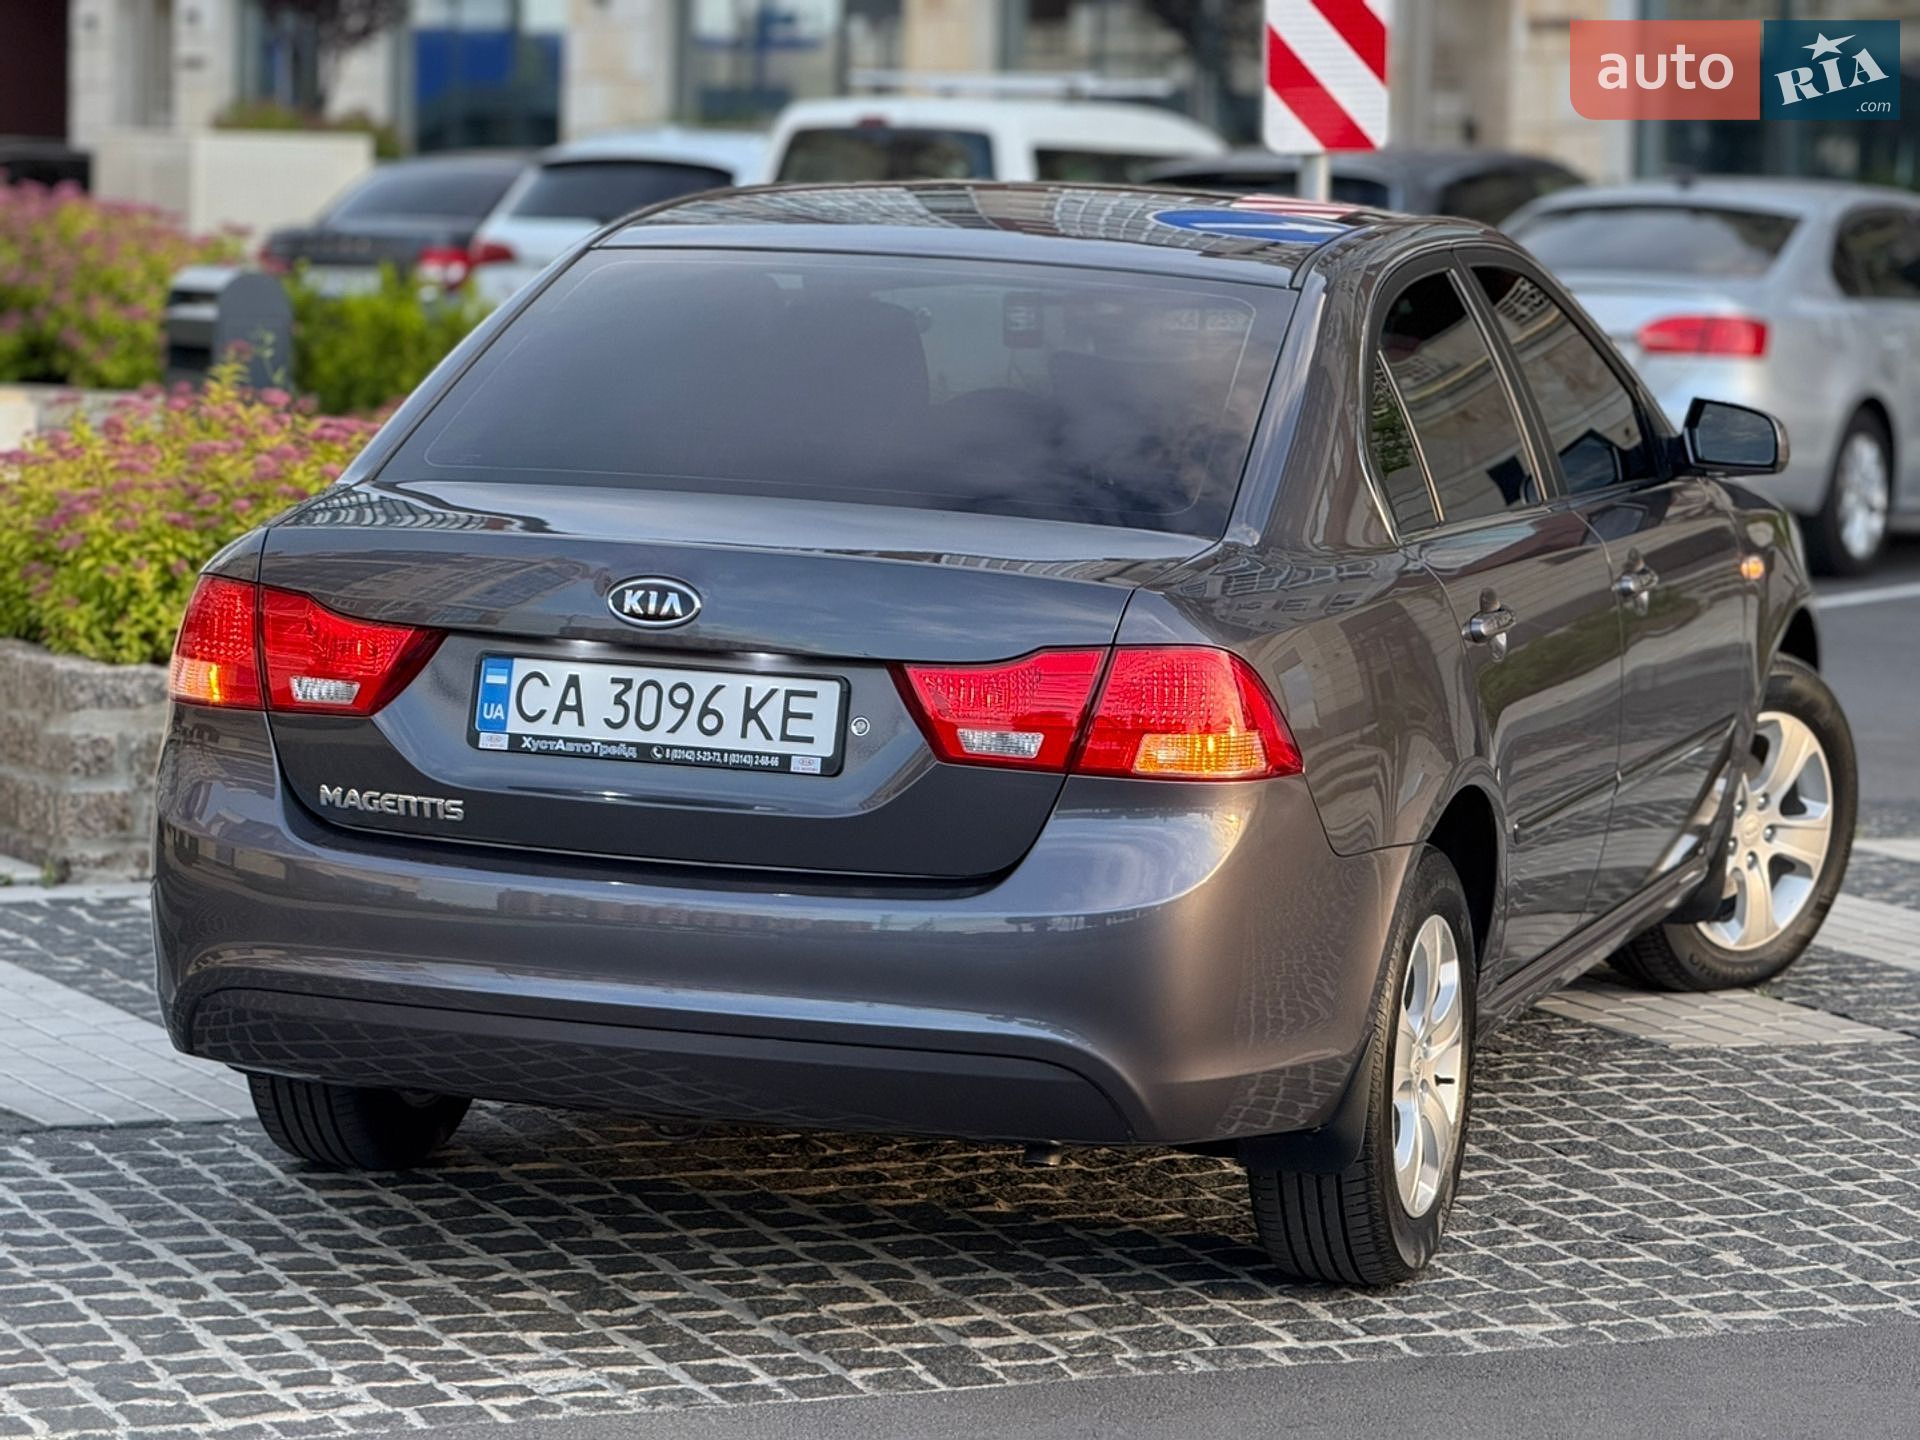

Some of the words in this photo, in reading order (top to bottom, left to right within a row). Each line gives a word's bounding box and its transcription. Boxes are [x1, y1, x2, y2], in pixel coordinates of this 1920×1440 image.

[623, 589, 683, 617] KIA
[483, 702, 505, 721] UA
[515, 670, 585, 727] CA
[603, 677, 727, 737] 3096
[740, 686, 818, 744] KE
[319, 784, 465, 821] MAGENTIS
